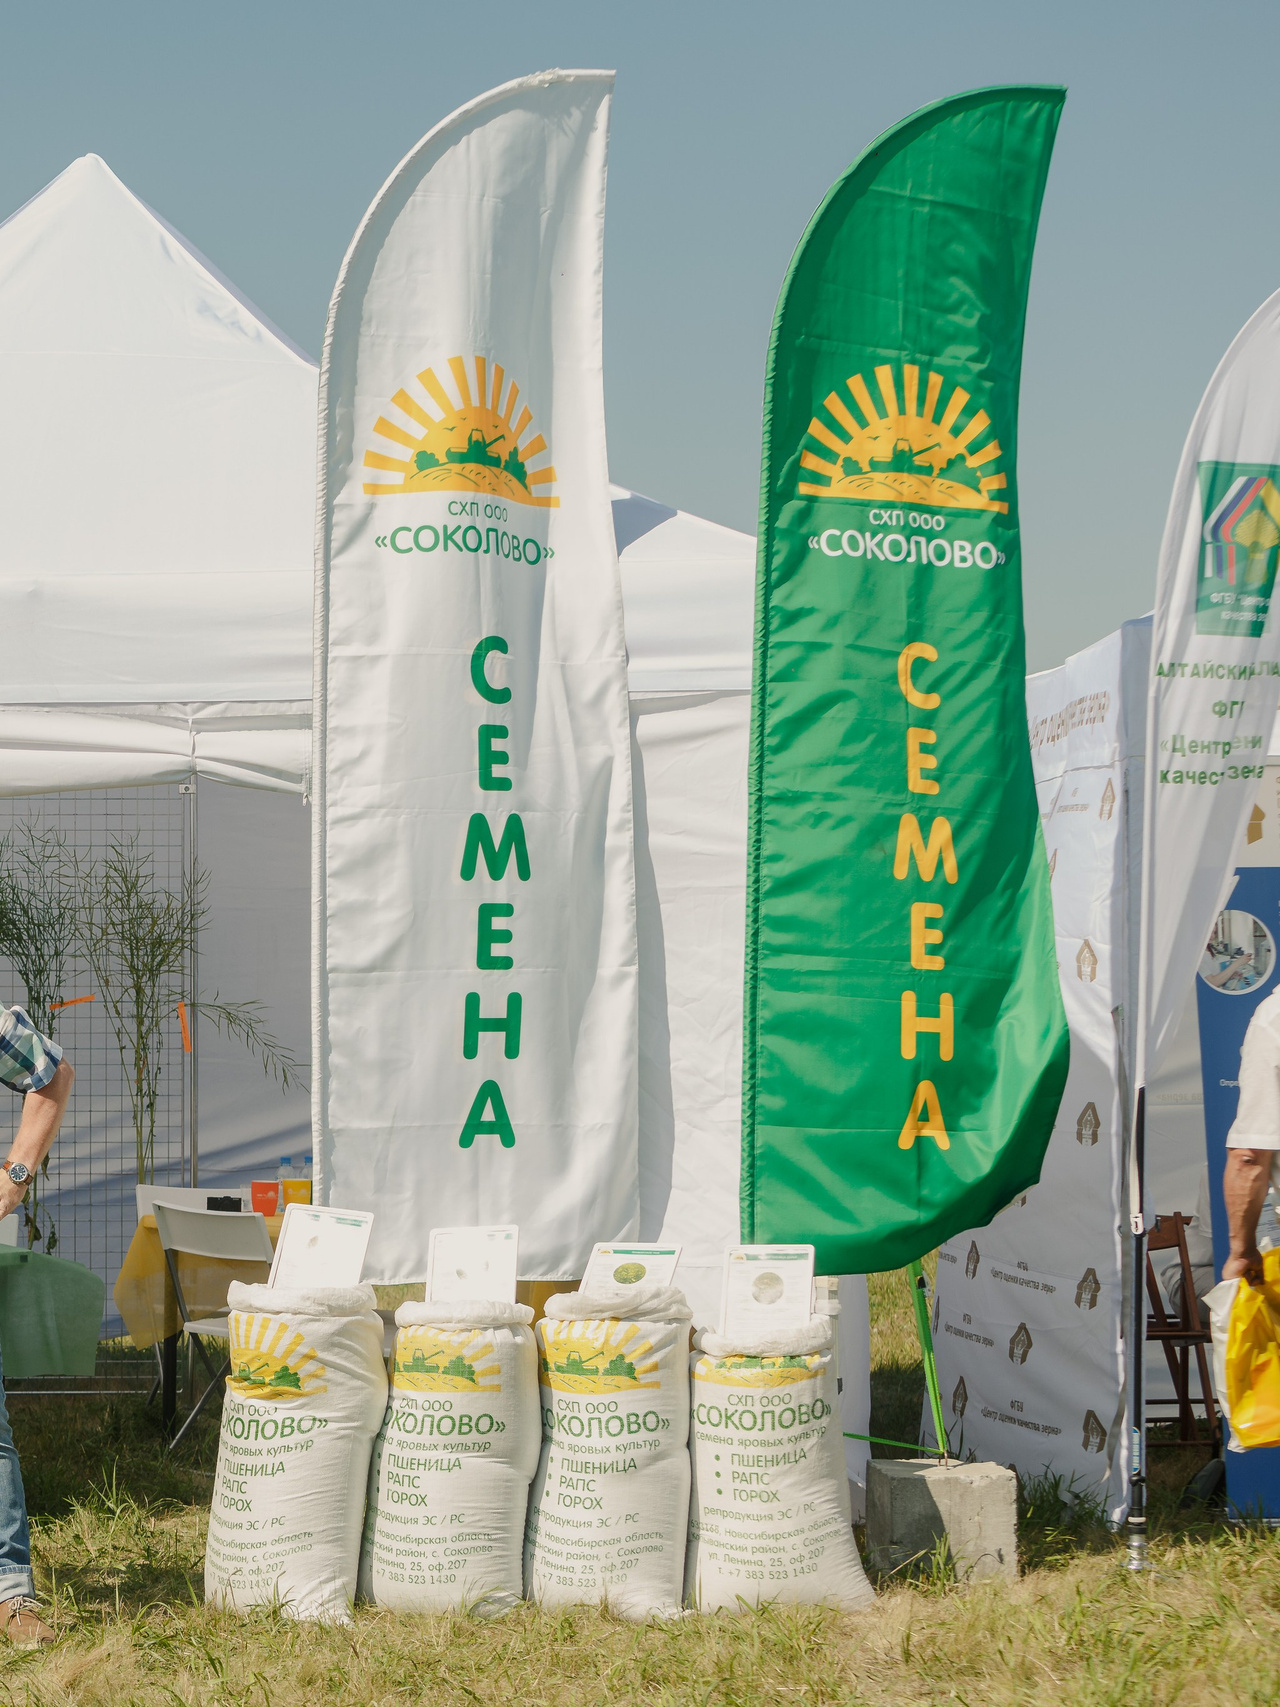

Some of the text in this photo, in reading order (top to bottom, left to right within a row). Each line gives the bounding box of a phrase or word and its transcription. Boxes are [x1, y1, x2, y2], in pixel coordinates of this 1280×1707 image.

[448, 500, 508, 522] СХП ООО
[869, 509, 945, 531] СХП ООО
[374, 524, 555, 566] «СОКОЛОВО»
[808, 529, 1006, 569] «СОКОЛОВО»
[1212, 700, 1245, 718] ФГ
[1160, 769, 1225, 785] качес
[458, 635, 531, 1149] СЕМЕНА
[893, 642, 959, 1150] СЕМЕНА
[400, 1398, 453, 1411] СХП ООО
[557, 1399, 618, 1414] СХП ООО
[728, 1393, 792, 1407] СХП ООО
[396, 1438, 439, 1451] яровых
[443, 1441, 491, 1453] культур
[695, 1425, 827, 1449] семена яровых культур
[230, 1445, 263, 1458] яровых
[267, 1439, 314, 1458] культур
[568, 1443, 611, 1455] яровых
[615, 1439, 660, 1454] культур
[388, 1454, 462, 1473] ПШЕНИЦА
[561, 1458, 637, 1474] ПШЕНИЦА
[731, 1448, 807, 1468] ПШЕНИЦА
[224, 1458, 286, 1477] ПШЕНИЦА
[222, 1476, 247, 1494] РАПС
[388, 1471, 420, 1488] РАПС
[559, 1475, 596, 1492] РАПС
[732, 1471, 770, 1485] РАПС
[220, 1494, 252, 1512] ГОРОХ
[387, 1488, 428, 1507] ГОРОХ
[557, 1493, 603, 1510] ГОРОХ
[733, 1489, 781, 1503] ГОРОХ
[704, 1506, 773, 1522] репродукция
[778, 1509, 792, 1520] ЭС
[803, 1502, 816, 1513] РС
[246, 1516, 286, 1530] ЭС РС
[545, 1530, 664, 1549] Новосибирская область
[389, 1572, 405, 1583] 383
[408, 1574, 426, 1584] 523
[430, 1574, 456, 1584] 1430
